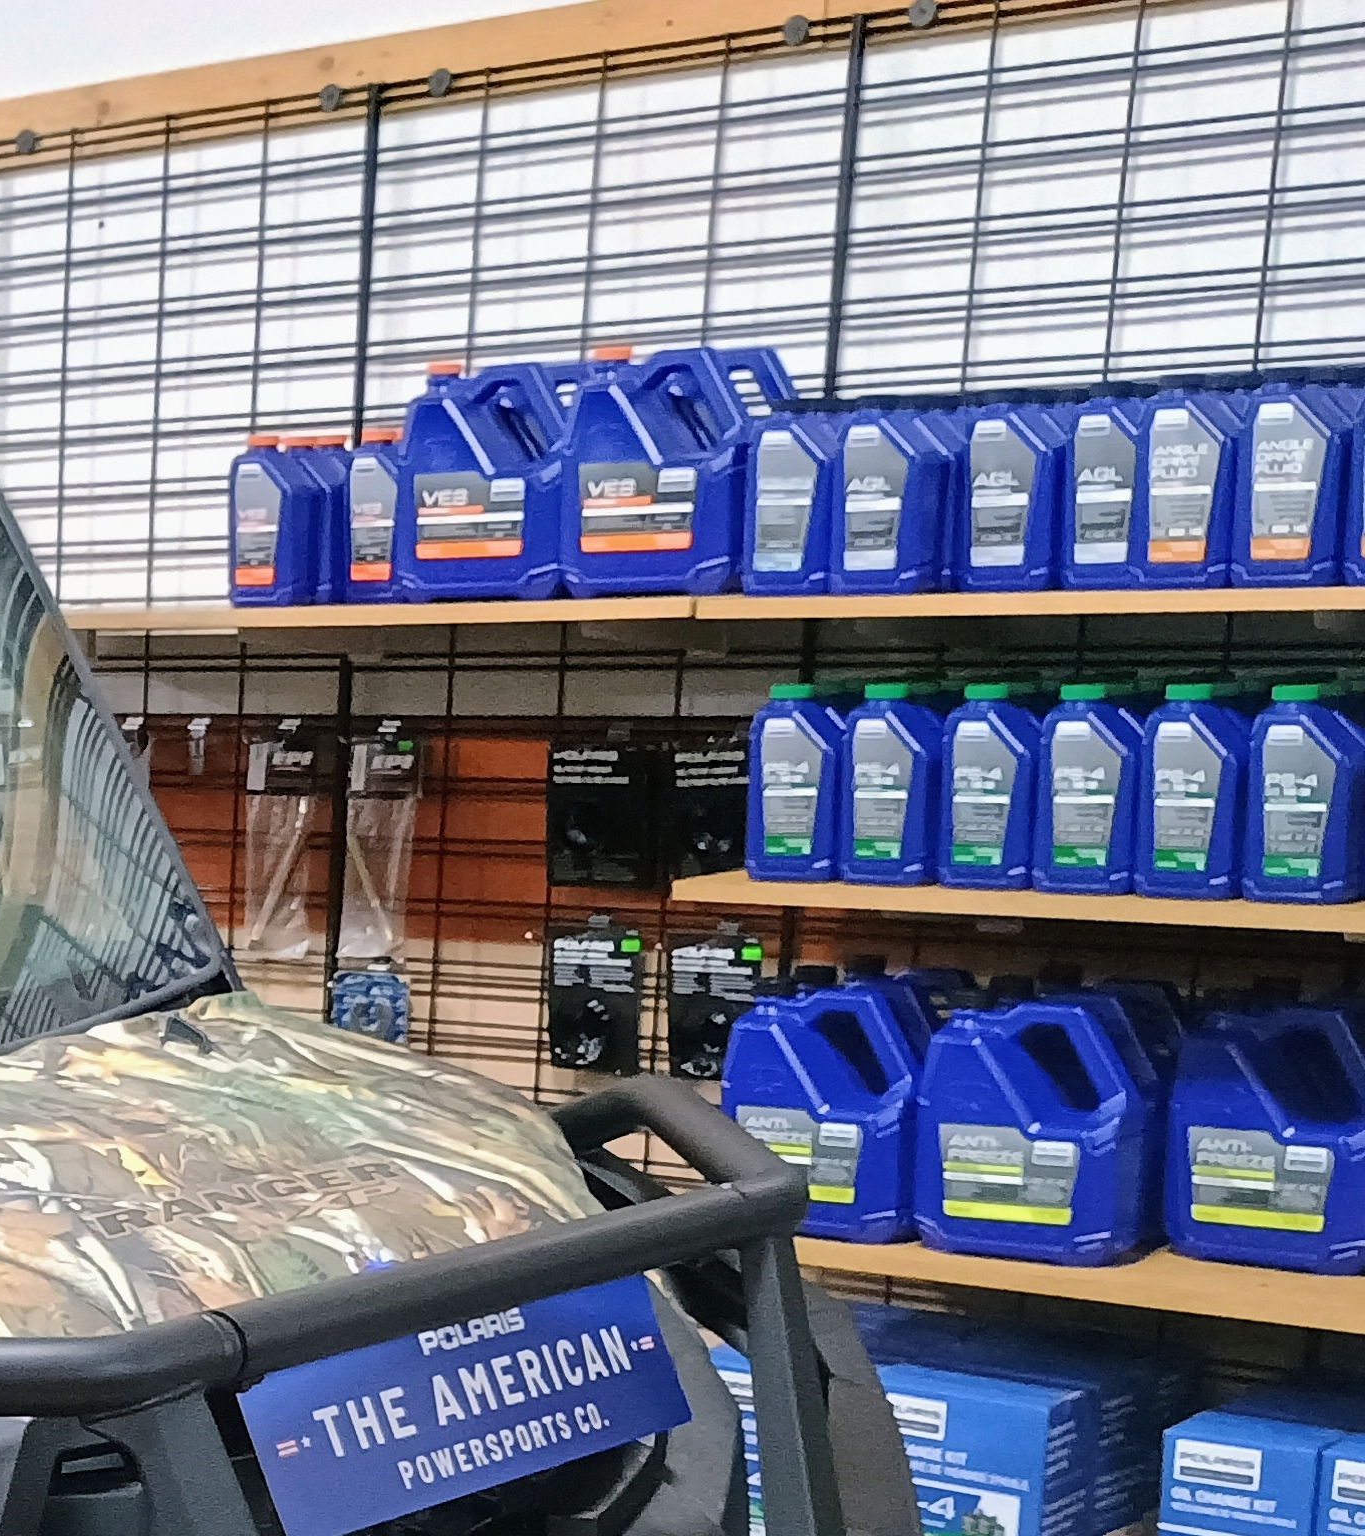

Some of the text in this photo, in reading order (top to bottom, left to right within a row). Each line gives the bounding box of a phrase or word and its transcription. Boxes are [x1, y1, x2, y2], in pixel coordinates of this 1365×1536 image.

[973, 470, 1019, 487] AGL
[1078, 465, 1123, 482] AGL
[417, 1307, 525, 1357] POLARIS
[312, 1325, 632, 1458] THE AMERICAN
[398, 1402, 611, 1490] POWERSPORTS CO.
